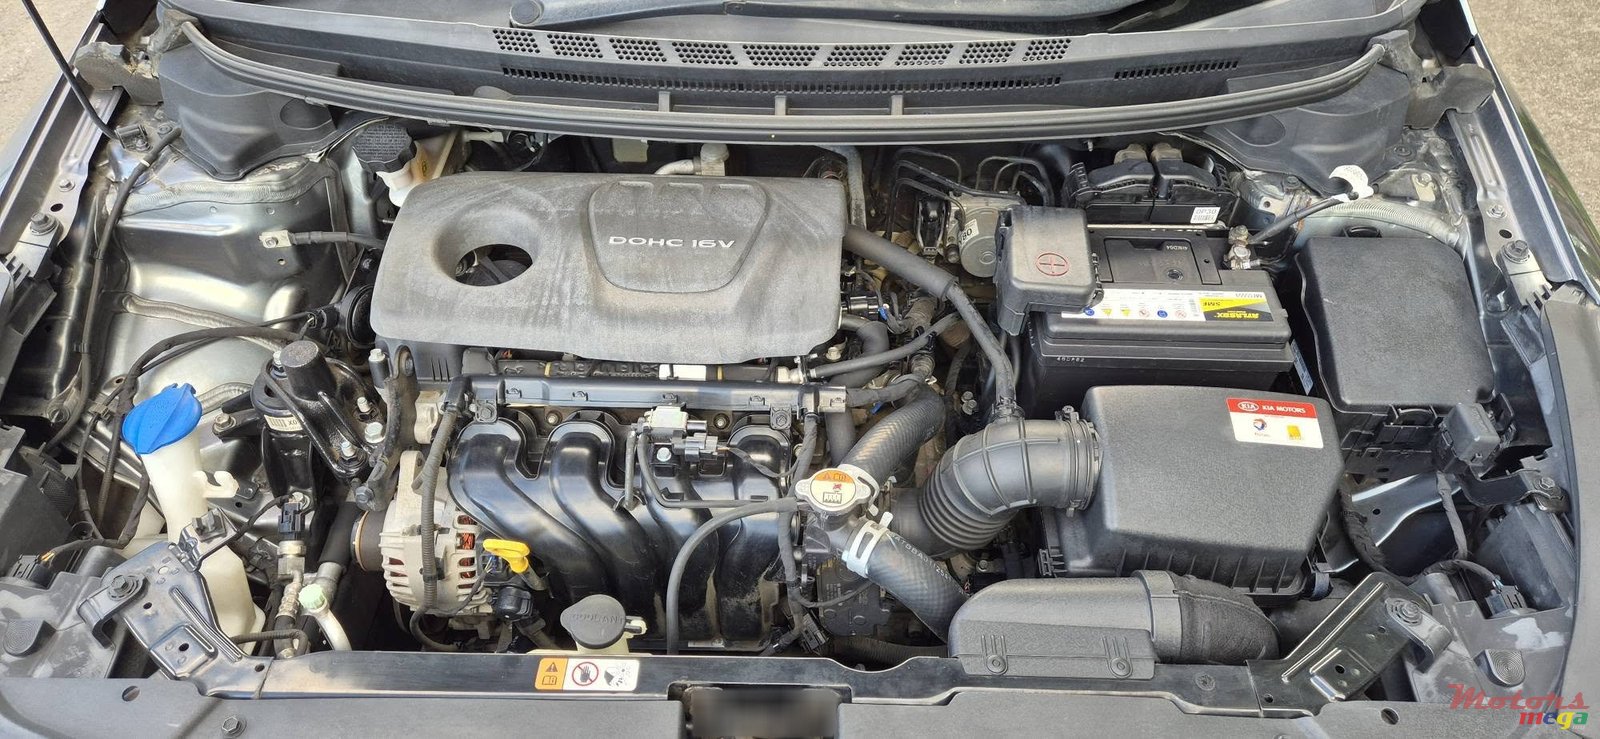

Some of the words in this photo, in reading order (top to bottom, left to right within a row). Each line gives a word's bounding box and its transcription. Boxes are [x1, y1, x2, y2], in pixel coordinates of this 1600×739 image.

[608, 235, 684, 248] DOHC
[692, 239, 735, 249] 16V
[1262, 404, 1275, 412] KIA
[1276, 405, 1306, 414] MOTORS
